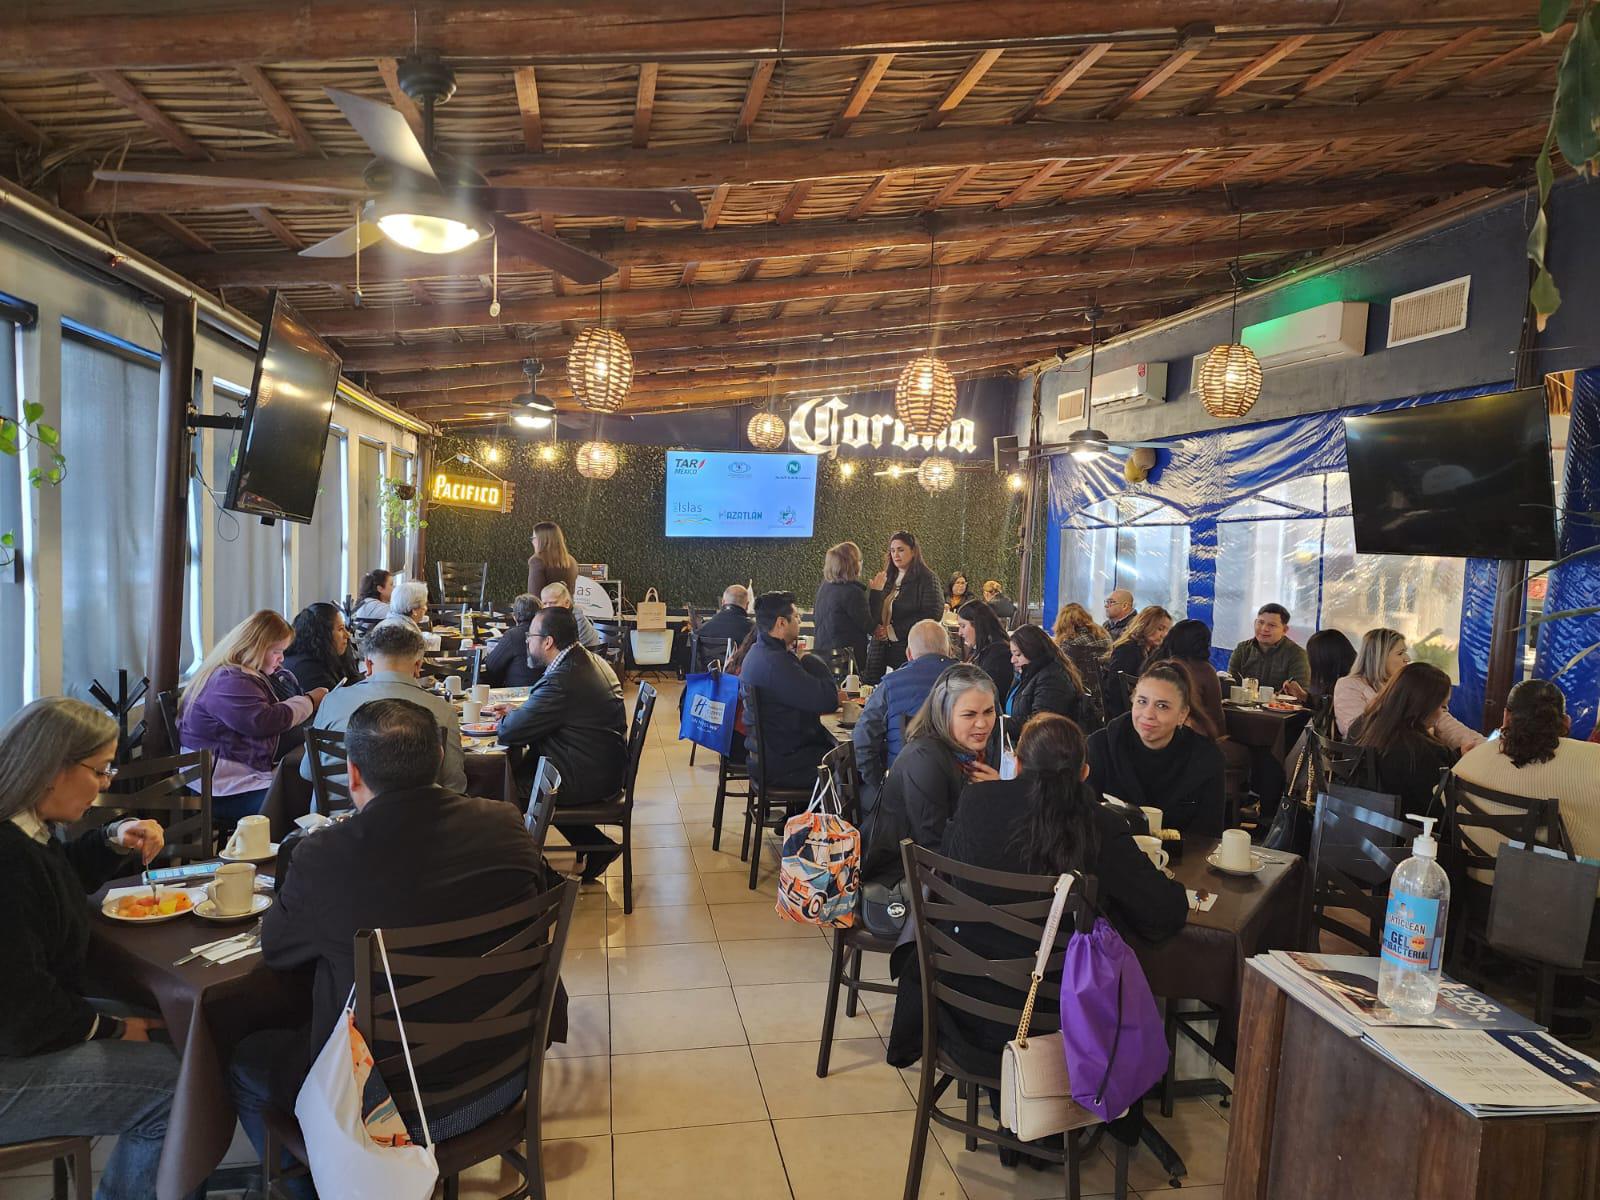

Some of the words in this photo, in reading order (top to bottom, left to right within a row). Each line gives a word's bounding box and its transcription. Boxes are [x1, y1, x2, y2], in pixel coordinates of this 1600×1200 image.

[675, 458, 698, 468] TAR
[433, 474, 499, 505] PACIFICO
[678, 501, 703, 513] Islas
[1384, 940, 1429, 960] BACTERIAL
[1391, 931, 1410, 950] GEL
